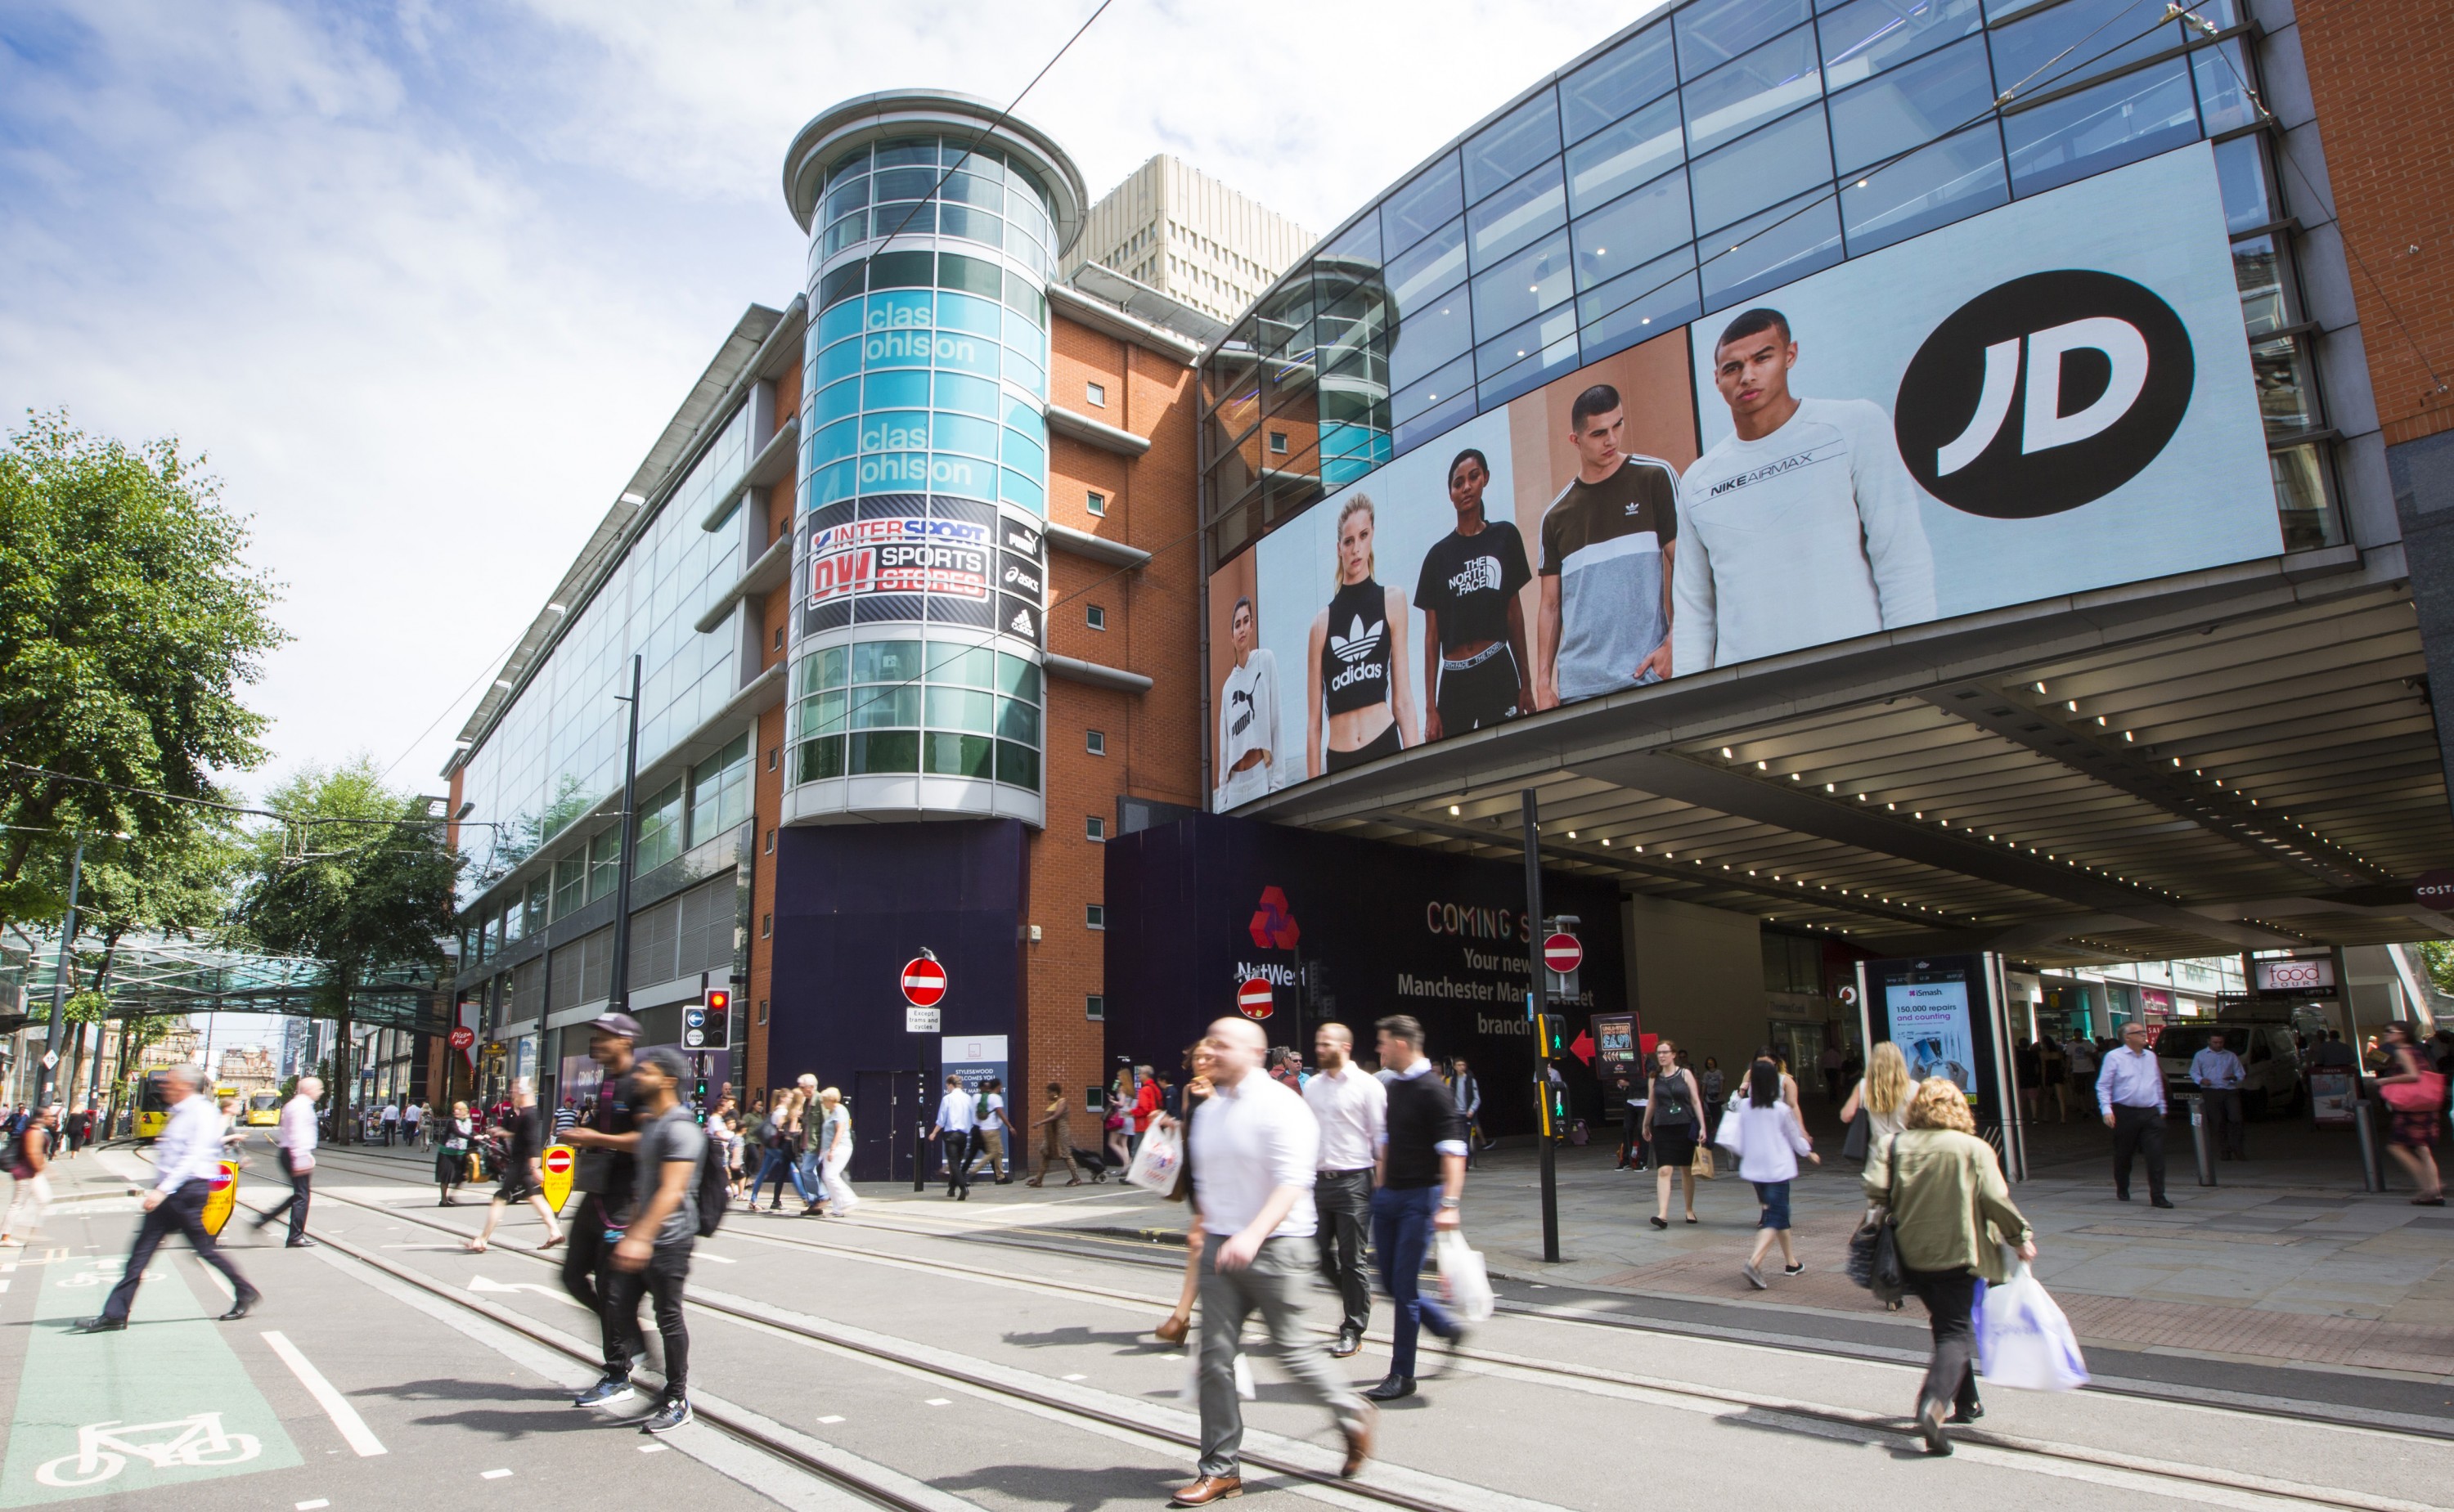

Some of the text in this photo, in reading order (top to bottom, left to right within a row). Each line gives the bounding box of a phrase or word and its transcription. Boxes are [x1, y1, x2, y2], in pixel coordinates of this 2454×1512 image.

[867, 302, 932, 329] clas
[866, 330, 975, 363] ohlson
[1938, 316, 2149, 477] JD
[861, 423, 927, 451] clas
[860, 452, 972, 486] ohlson
[834, 520, 986, 550] INTERSPORT
[1009, 532, 1035, 555] PUMA
[881, 546, 982, 572] SPORTS
[1464, 555, 1486, 571] THE
[814, 550, 872, 599] DW
[882, 568, 982, 594] STORES
[1448, 565, 1487, 590] NORTH
[1458, 576, 1487, 596] FACE
[1332, 661, 1382, 692] adidas
[1455, 661, 1470, 669] FACE
[1231, 709, 1251, 741] PUMA
[2417, 885, 2454, 895] COST
[1427, 901, 1511, 940] COMING
[1463, 948, 1498, 971] Your
[2269, 961, 2320, 982] food
[1398, 974, 1494, 1000] Manchester
[1916, 989, 1943, 997] iSmash
[2270, 980, 2321, 988] COURT
[1896, 1004, 1957, 1013] 150,000 repairs
[452, 1031, 472, 1039] Pizza
[1477, 1012, 1530, 1035] branch
[1602, 1034, 1630, 1049] £6.99
